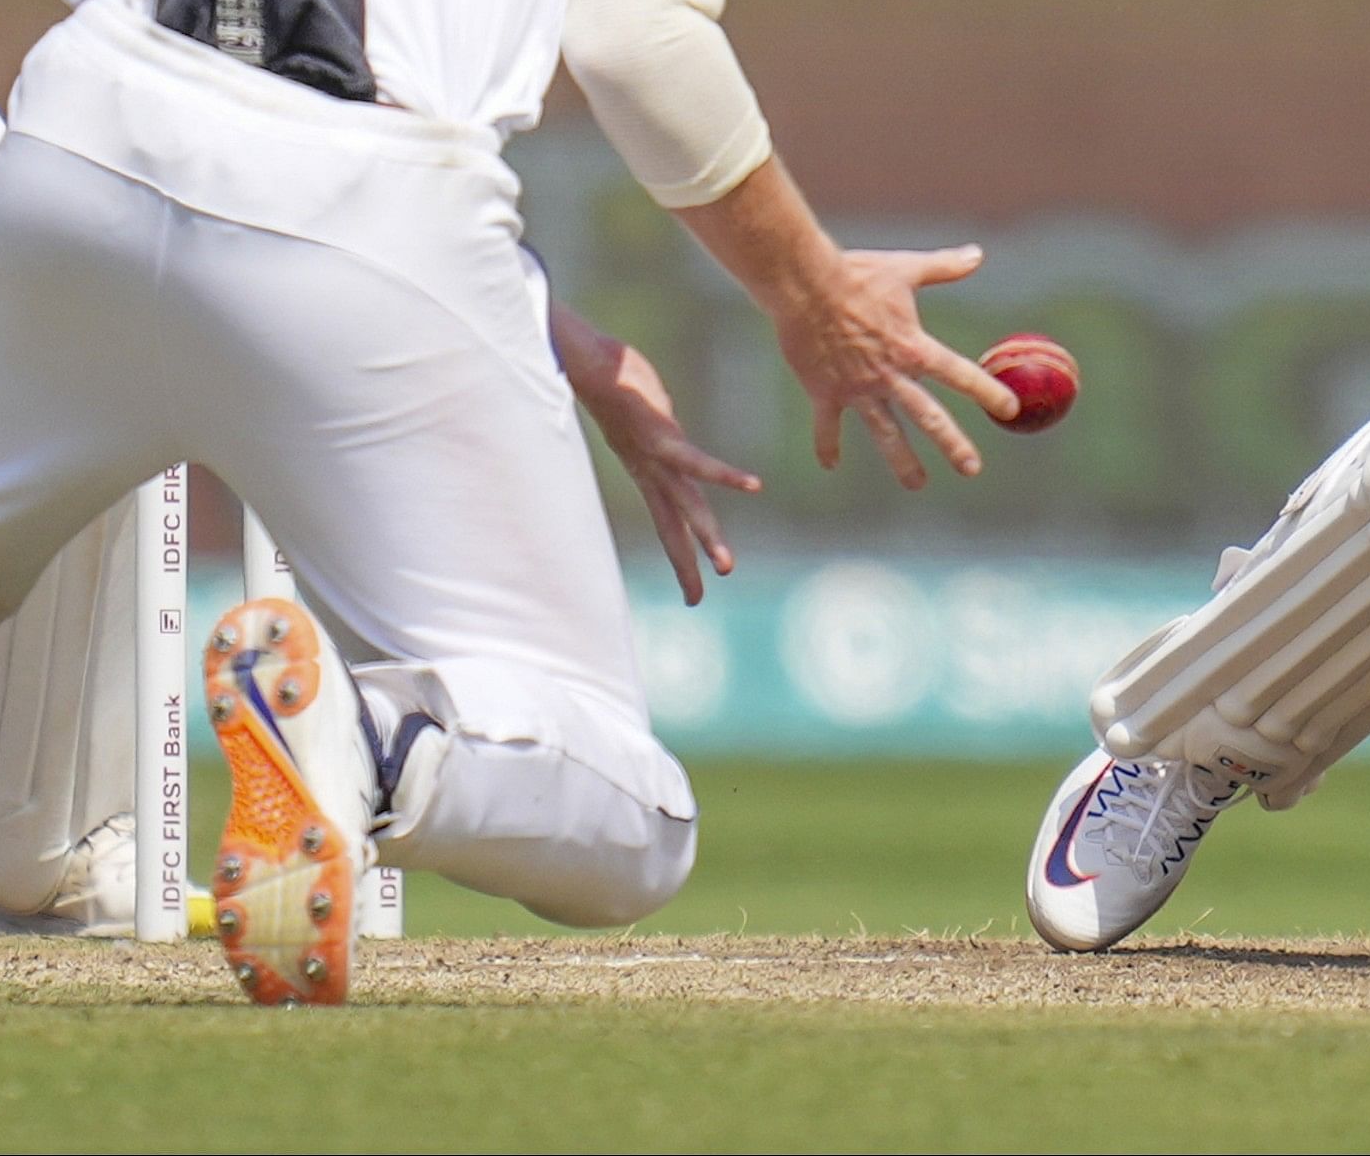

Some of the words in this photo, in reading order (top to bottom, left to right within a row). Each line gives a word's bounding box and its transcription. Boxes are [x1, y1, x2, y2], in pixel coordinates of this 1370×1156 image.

[163, 514, 180, 573] IDFC
[163, 694, 181, 758] Bank
[162, 767, 181, 841] FIRST
[162, 850, 181, 912] IDFC
